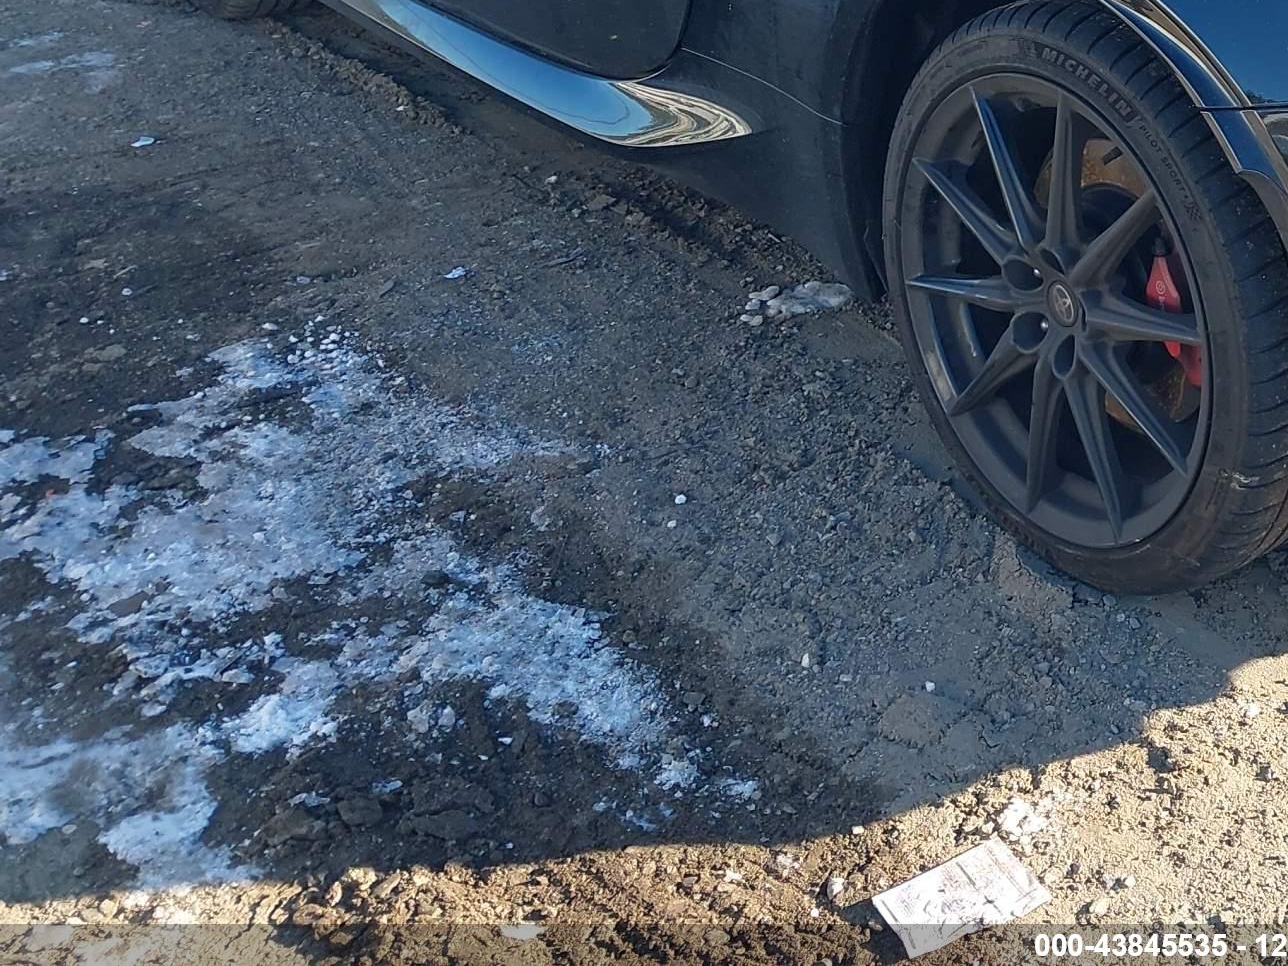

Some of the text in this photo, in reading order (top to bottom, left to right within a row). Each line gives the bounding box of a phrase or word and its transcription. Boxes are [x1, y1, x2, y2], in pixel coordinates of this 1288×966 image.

[1041, 46, 1133, 118] MICHELIN
[1138, 124, 1186, 192] PILOT SPORT
